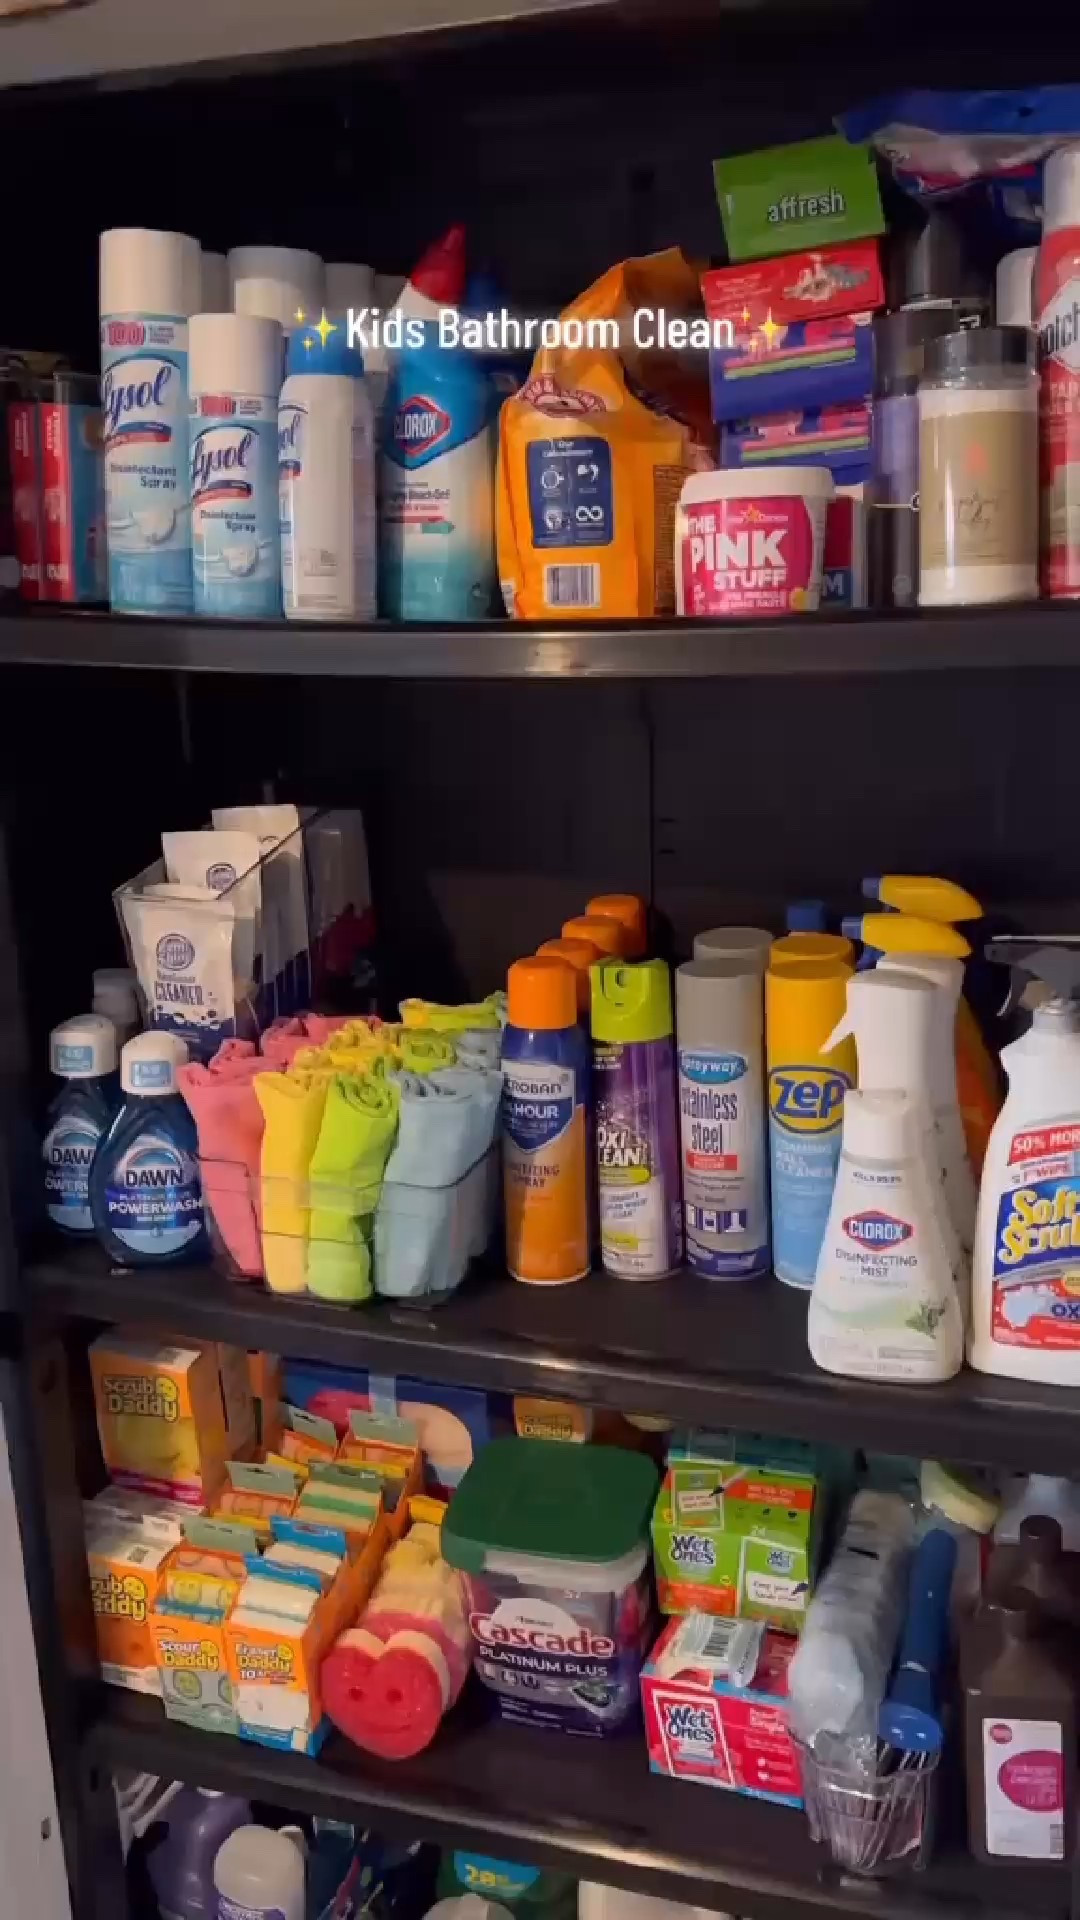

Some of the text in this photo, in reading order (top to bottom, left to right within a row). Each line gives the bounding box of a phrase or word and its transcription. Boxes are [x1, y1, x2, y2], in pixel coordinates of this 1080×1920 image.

[767, 185, 845, 223] affresh
[191, 430, 253, 492] Lysol
[690, 529, 788, 573] PINK
[713, 568, 788, 591] STUFF
[515, 1103, 560, 1119] HOUR
[691, 1120, 723, 1155] steel
[1014, 1129, 1080, 1154] 50% MOR
[125, 1168, 184, 1188] DAWN
[108, 1197, 202, 1216] POWERWASH
[850, 1219, 904, 1241] CLOROX
[835, 1248, 918, 1267] DISINFECTING
[860, 1267, 889, 1277] MIST
[107, 1393, 179, 1423] Daddy
[671, 1534, 715, 1553] Wet
[670, 1550, 716, 1566] Ones
[90, 1572, 123, 1597] rub
[92, 1593, 146, 1622] addy
[469, 1612, 616, 1659] Cascade
[164, 1653, 219, 1672] Daddy
[238, 1655, 291, 1674] Daddy
[479, 1645, 608, 1677] PLATINUM PLUS
[668, 1704, 714, 1729] Wet
[669, 1726, 716, 1744] Ones
